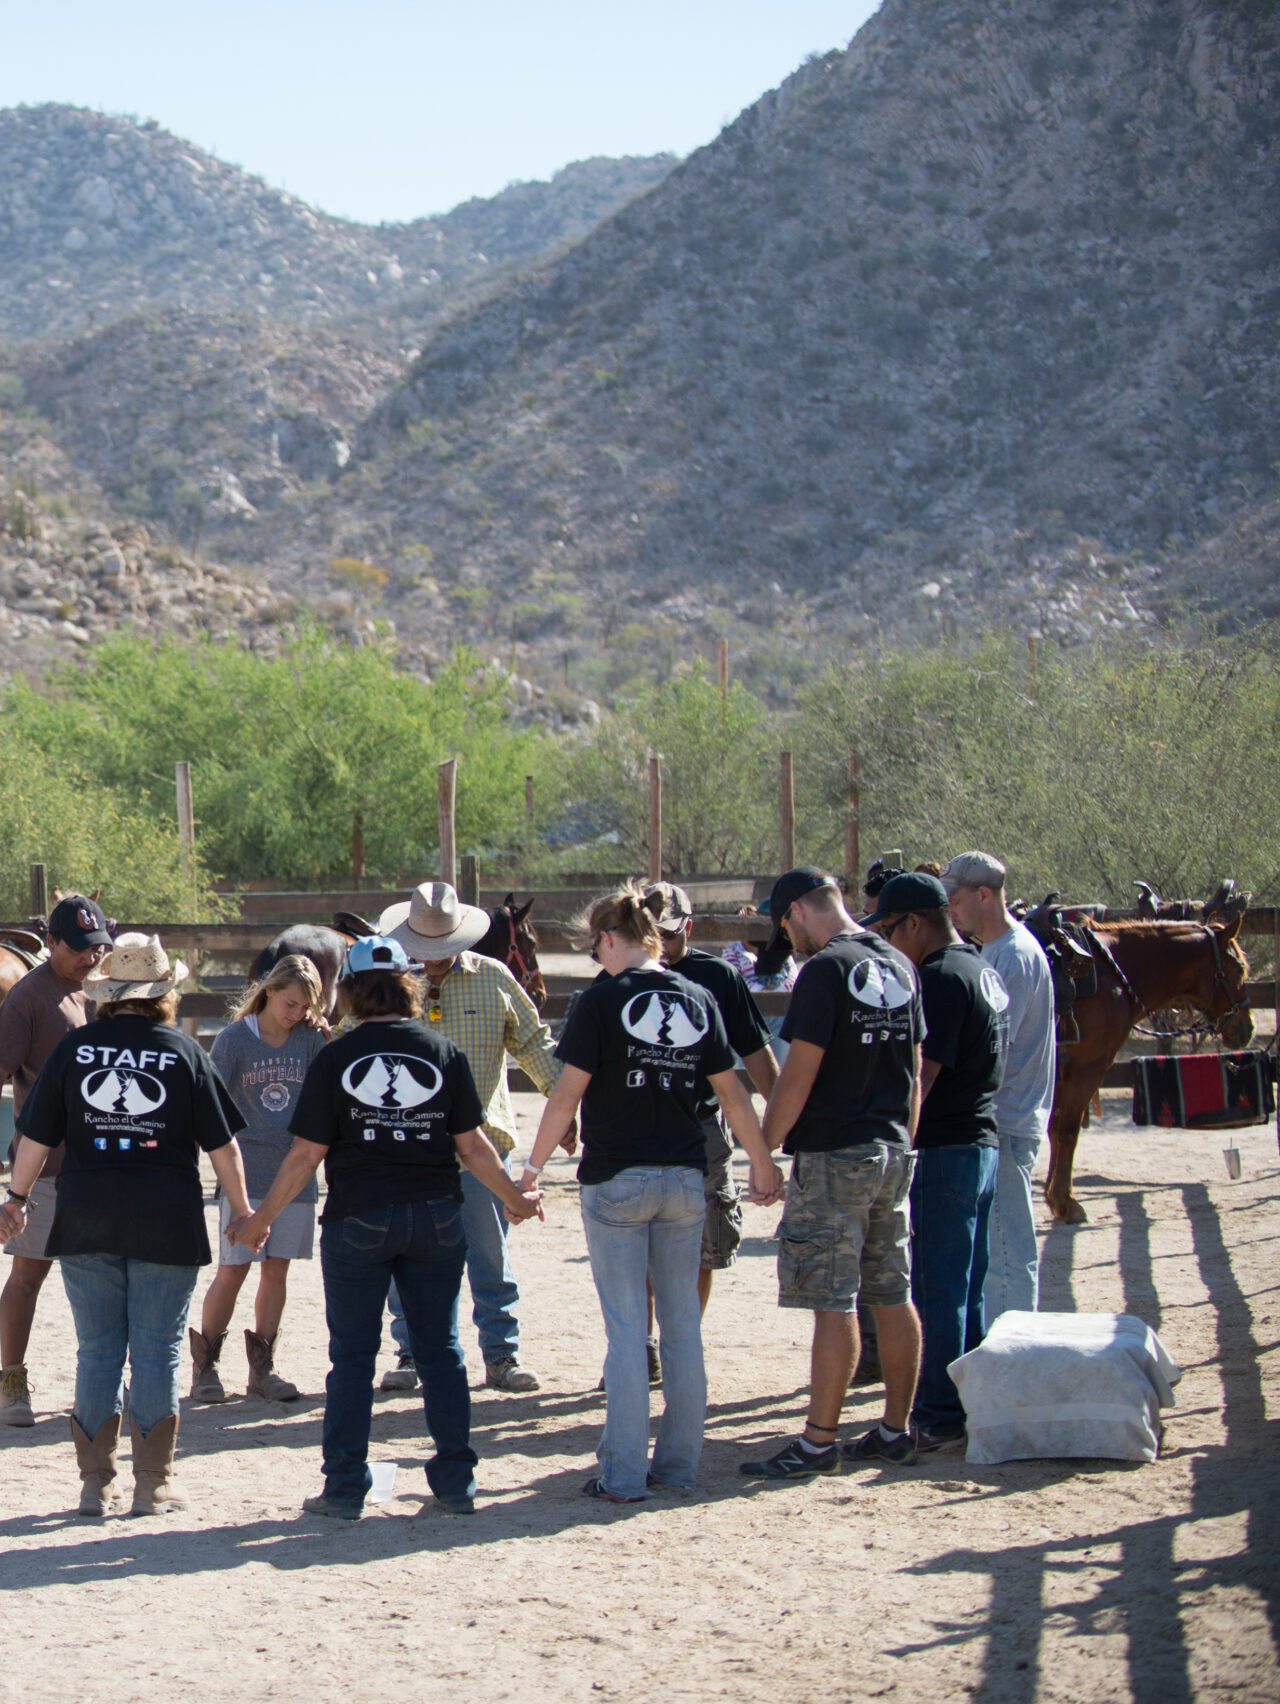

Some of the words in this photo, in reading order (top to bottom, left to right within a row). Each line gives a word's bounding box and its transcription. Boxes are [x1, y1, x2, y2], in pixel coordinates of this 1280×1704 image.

[75, 1045, 178, 1071] STAFF
[253, 1057, 301, 1069] VARSITY
[84, 1112, 120, 1124] Rancho
[121, 1114, 129, 1123] el
[130, 1116, 166, 1128] Camino
[350, 1108, 389, 1120] Rancho
[402, 1109, 445, 1121] Camino
